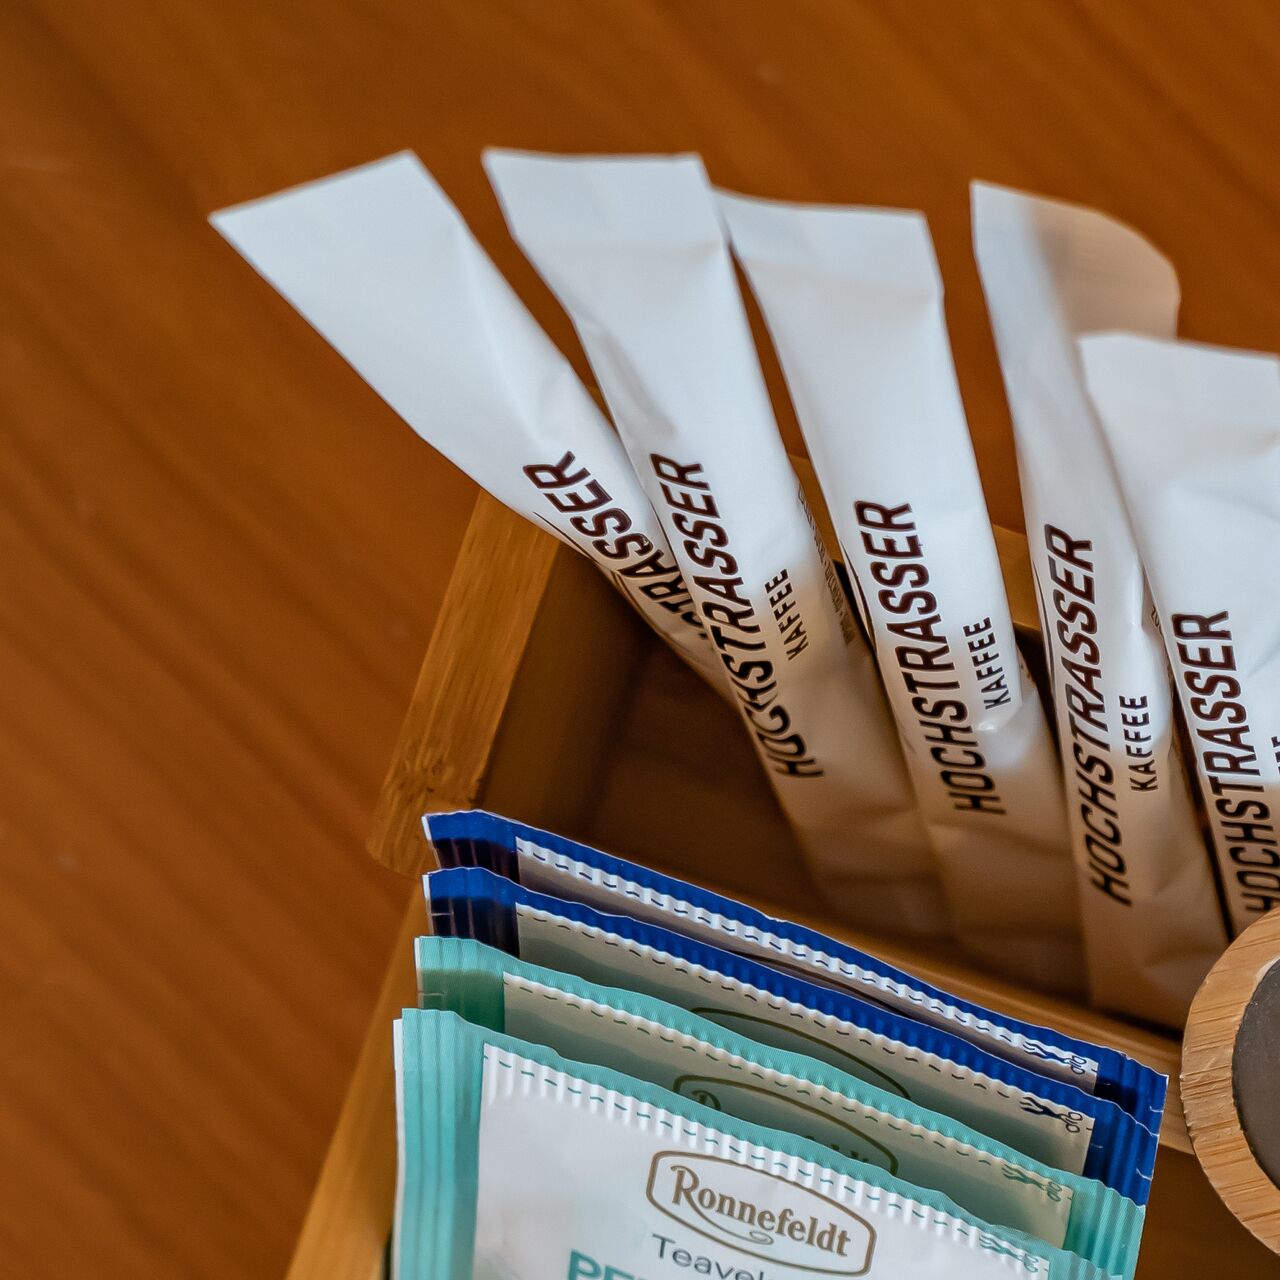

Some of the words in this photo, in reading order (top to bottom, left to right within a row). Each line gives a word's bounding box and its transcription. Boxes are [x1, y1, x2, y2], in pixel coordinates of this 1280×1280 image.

[650, 453, 824, 777] HOCHSTRASSER
[764, 568, 809, 661] KAFFEE
[853, 500, 1006, 815] HOCHSTRASSER
[963, 616, 1011, 710] KAFFEE
[1044, 523, 1133, 907] HOCHSTRASSER
[1118, 694, 1159, 792] KAFFEE
[669, 1164, 852, 1257] Ronnefeldt
